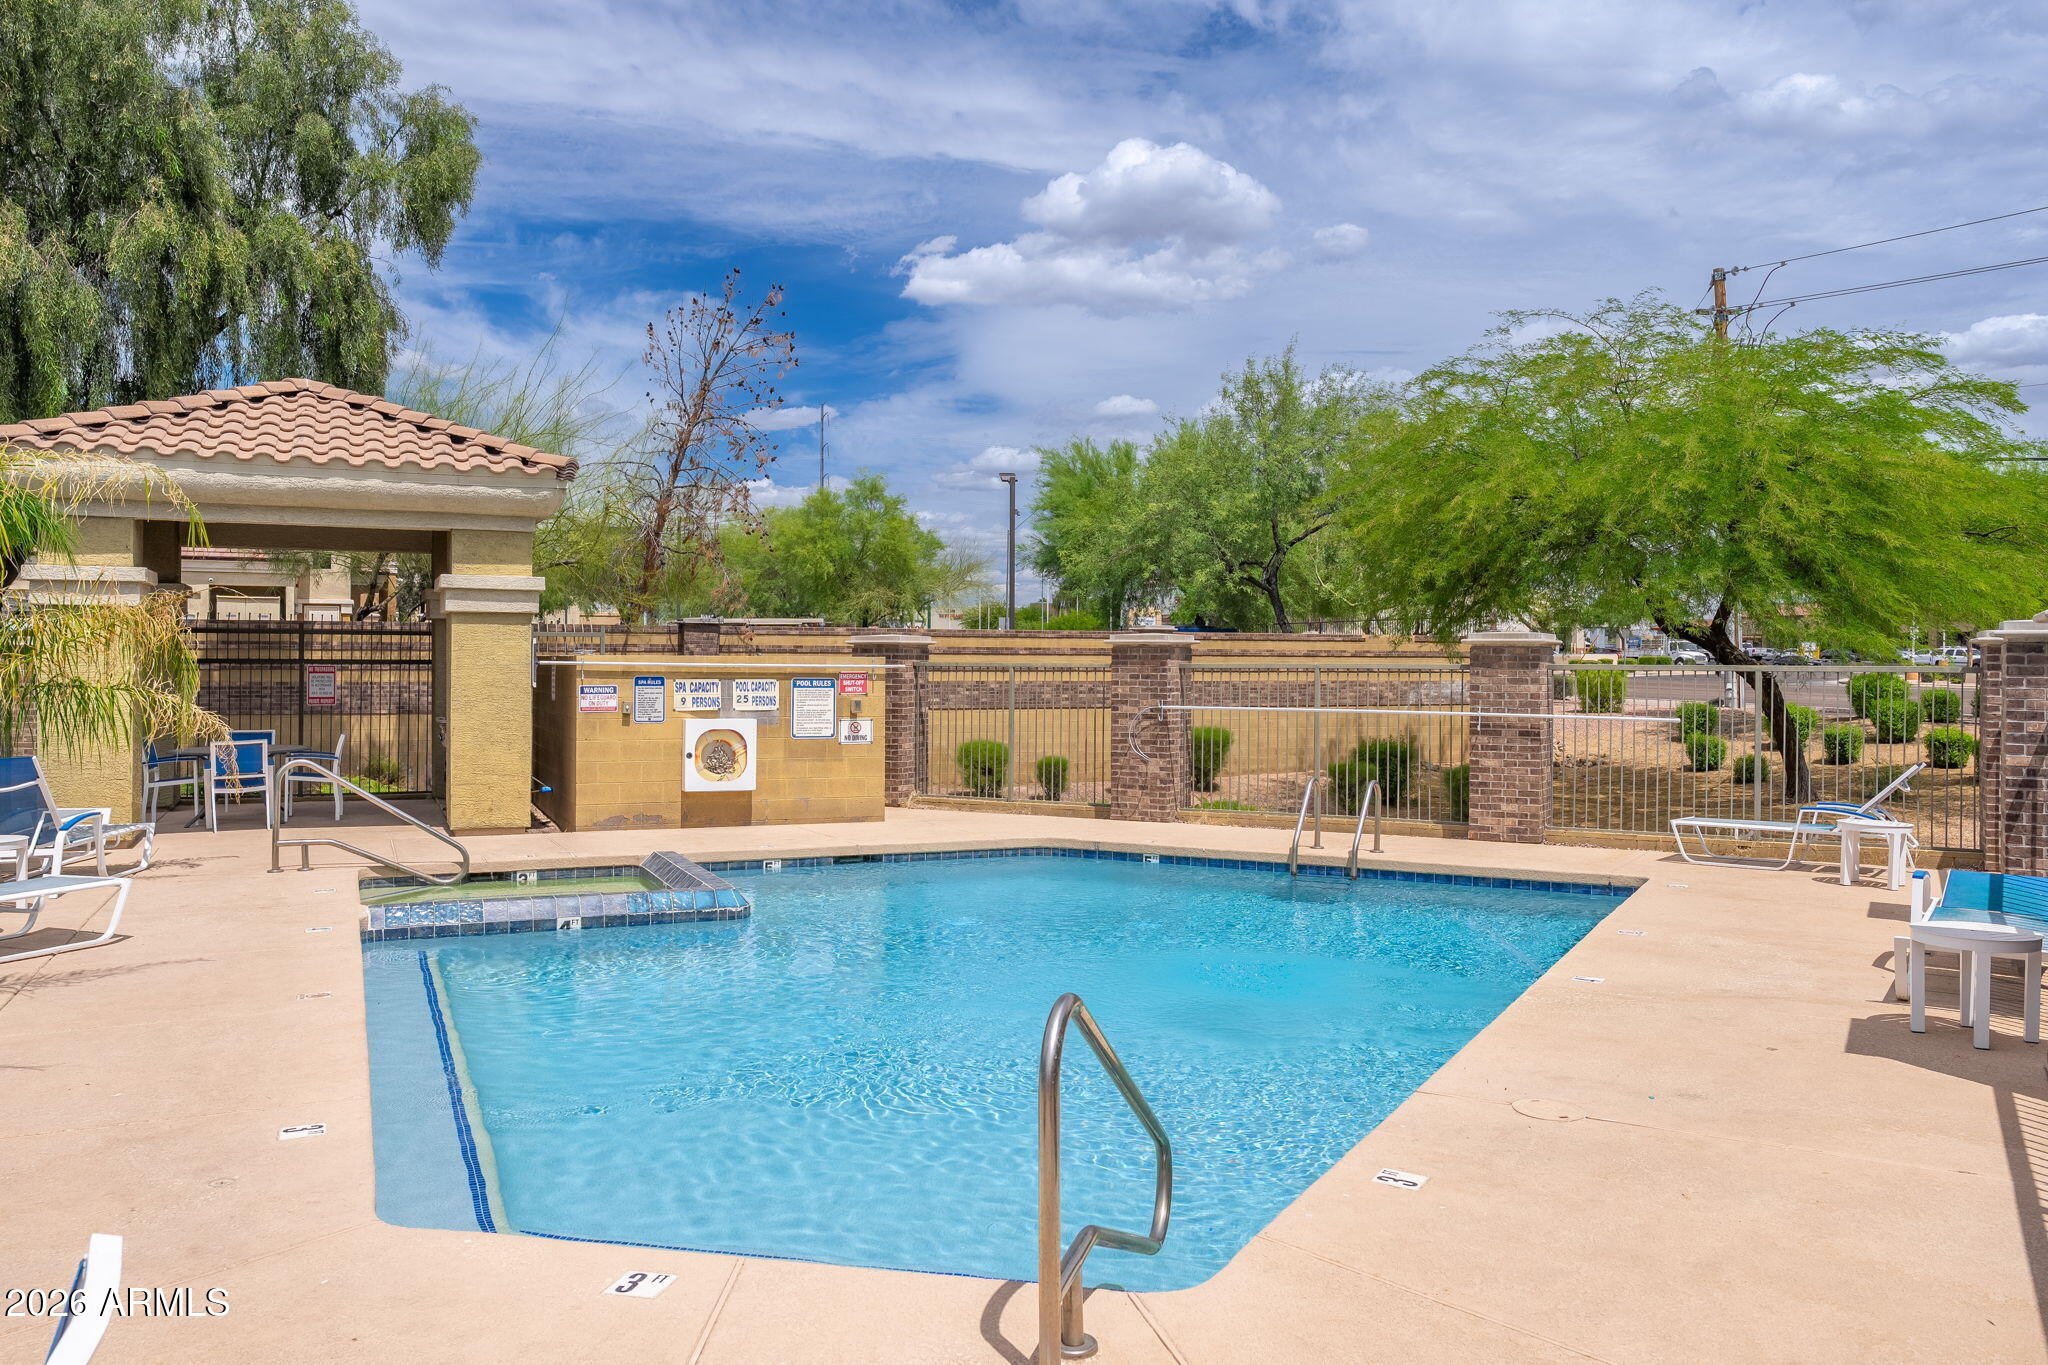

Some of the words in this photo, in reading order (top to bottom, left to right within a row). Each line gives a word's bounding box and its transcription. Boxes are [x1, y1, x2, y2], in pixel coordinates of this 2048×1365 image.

[583, 686, 614, 694] WARNING
[674, 681, 687, 693] SPA
[689, 681, 720, 693] CAPACITY
[735, 681, 750, 692] POOL
[750, 681, 777, 692] CAPACITY
[680, 696, 687, 706] 9
[691, 696, 721, 708] PERSONS
[736, 694, 749, 704] 25
[751, 695, 777, 707] PERSONS
[614, 1272, 648, 1293] 3
[651, 1274, 671, 1284] FT
